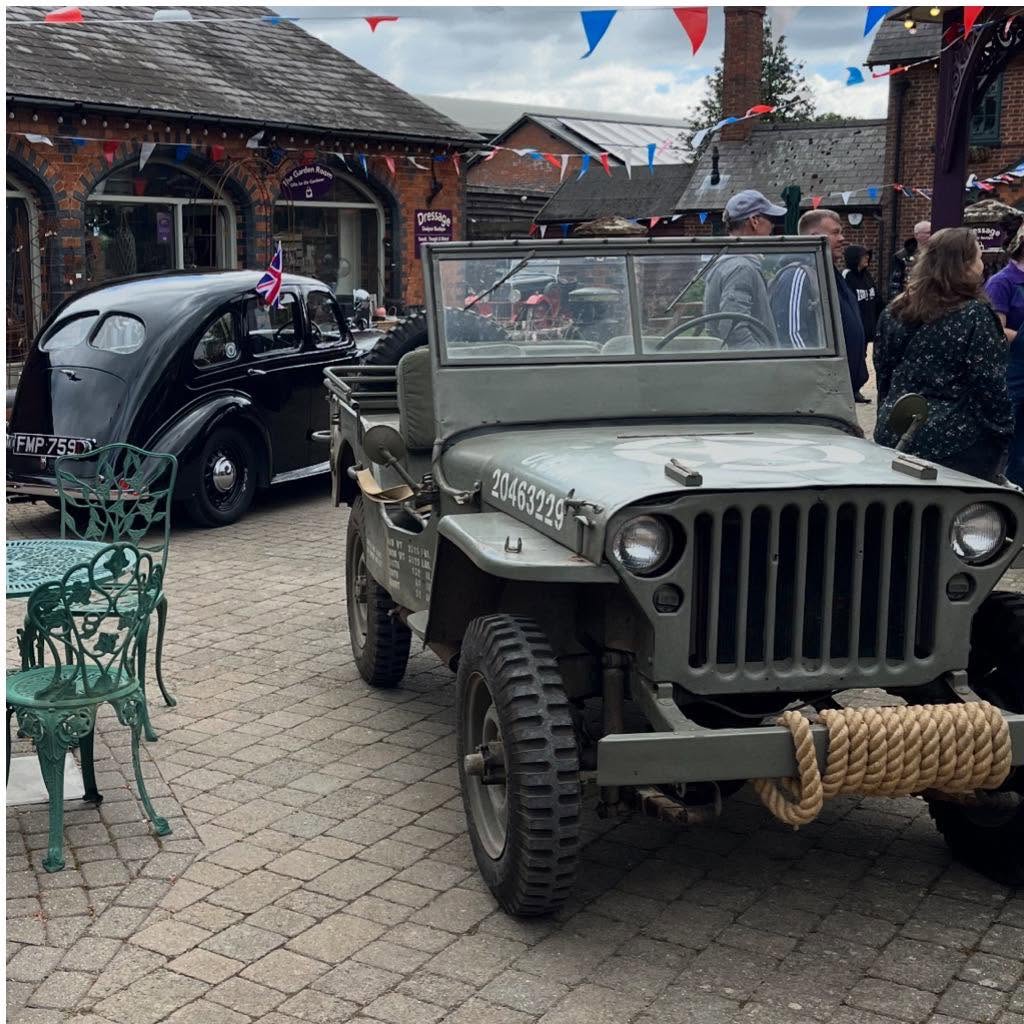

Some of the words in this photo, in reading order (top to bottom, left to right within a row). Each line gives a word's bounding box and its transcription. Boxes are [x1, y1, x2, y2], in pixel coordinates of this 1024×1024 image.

[293, 166, 315, 177] Garden
[316, 166, 333, 180] Room
[417, 212, 451, 227] Dressage
[16, 436, 44, 453] FMP
[47, 438, 76, 456] 759
[491, 468, 565, 531] 20463229
